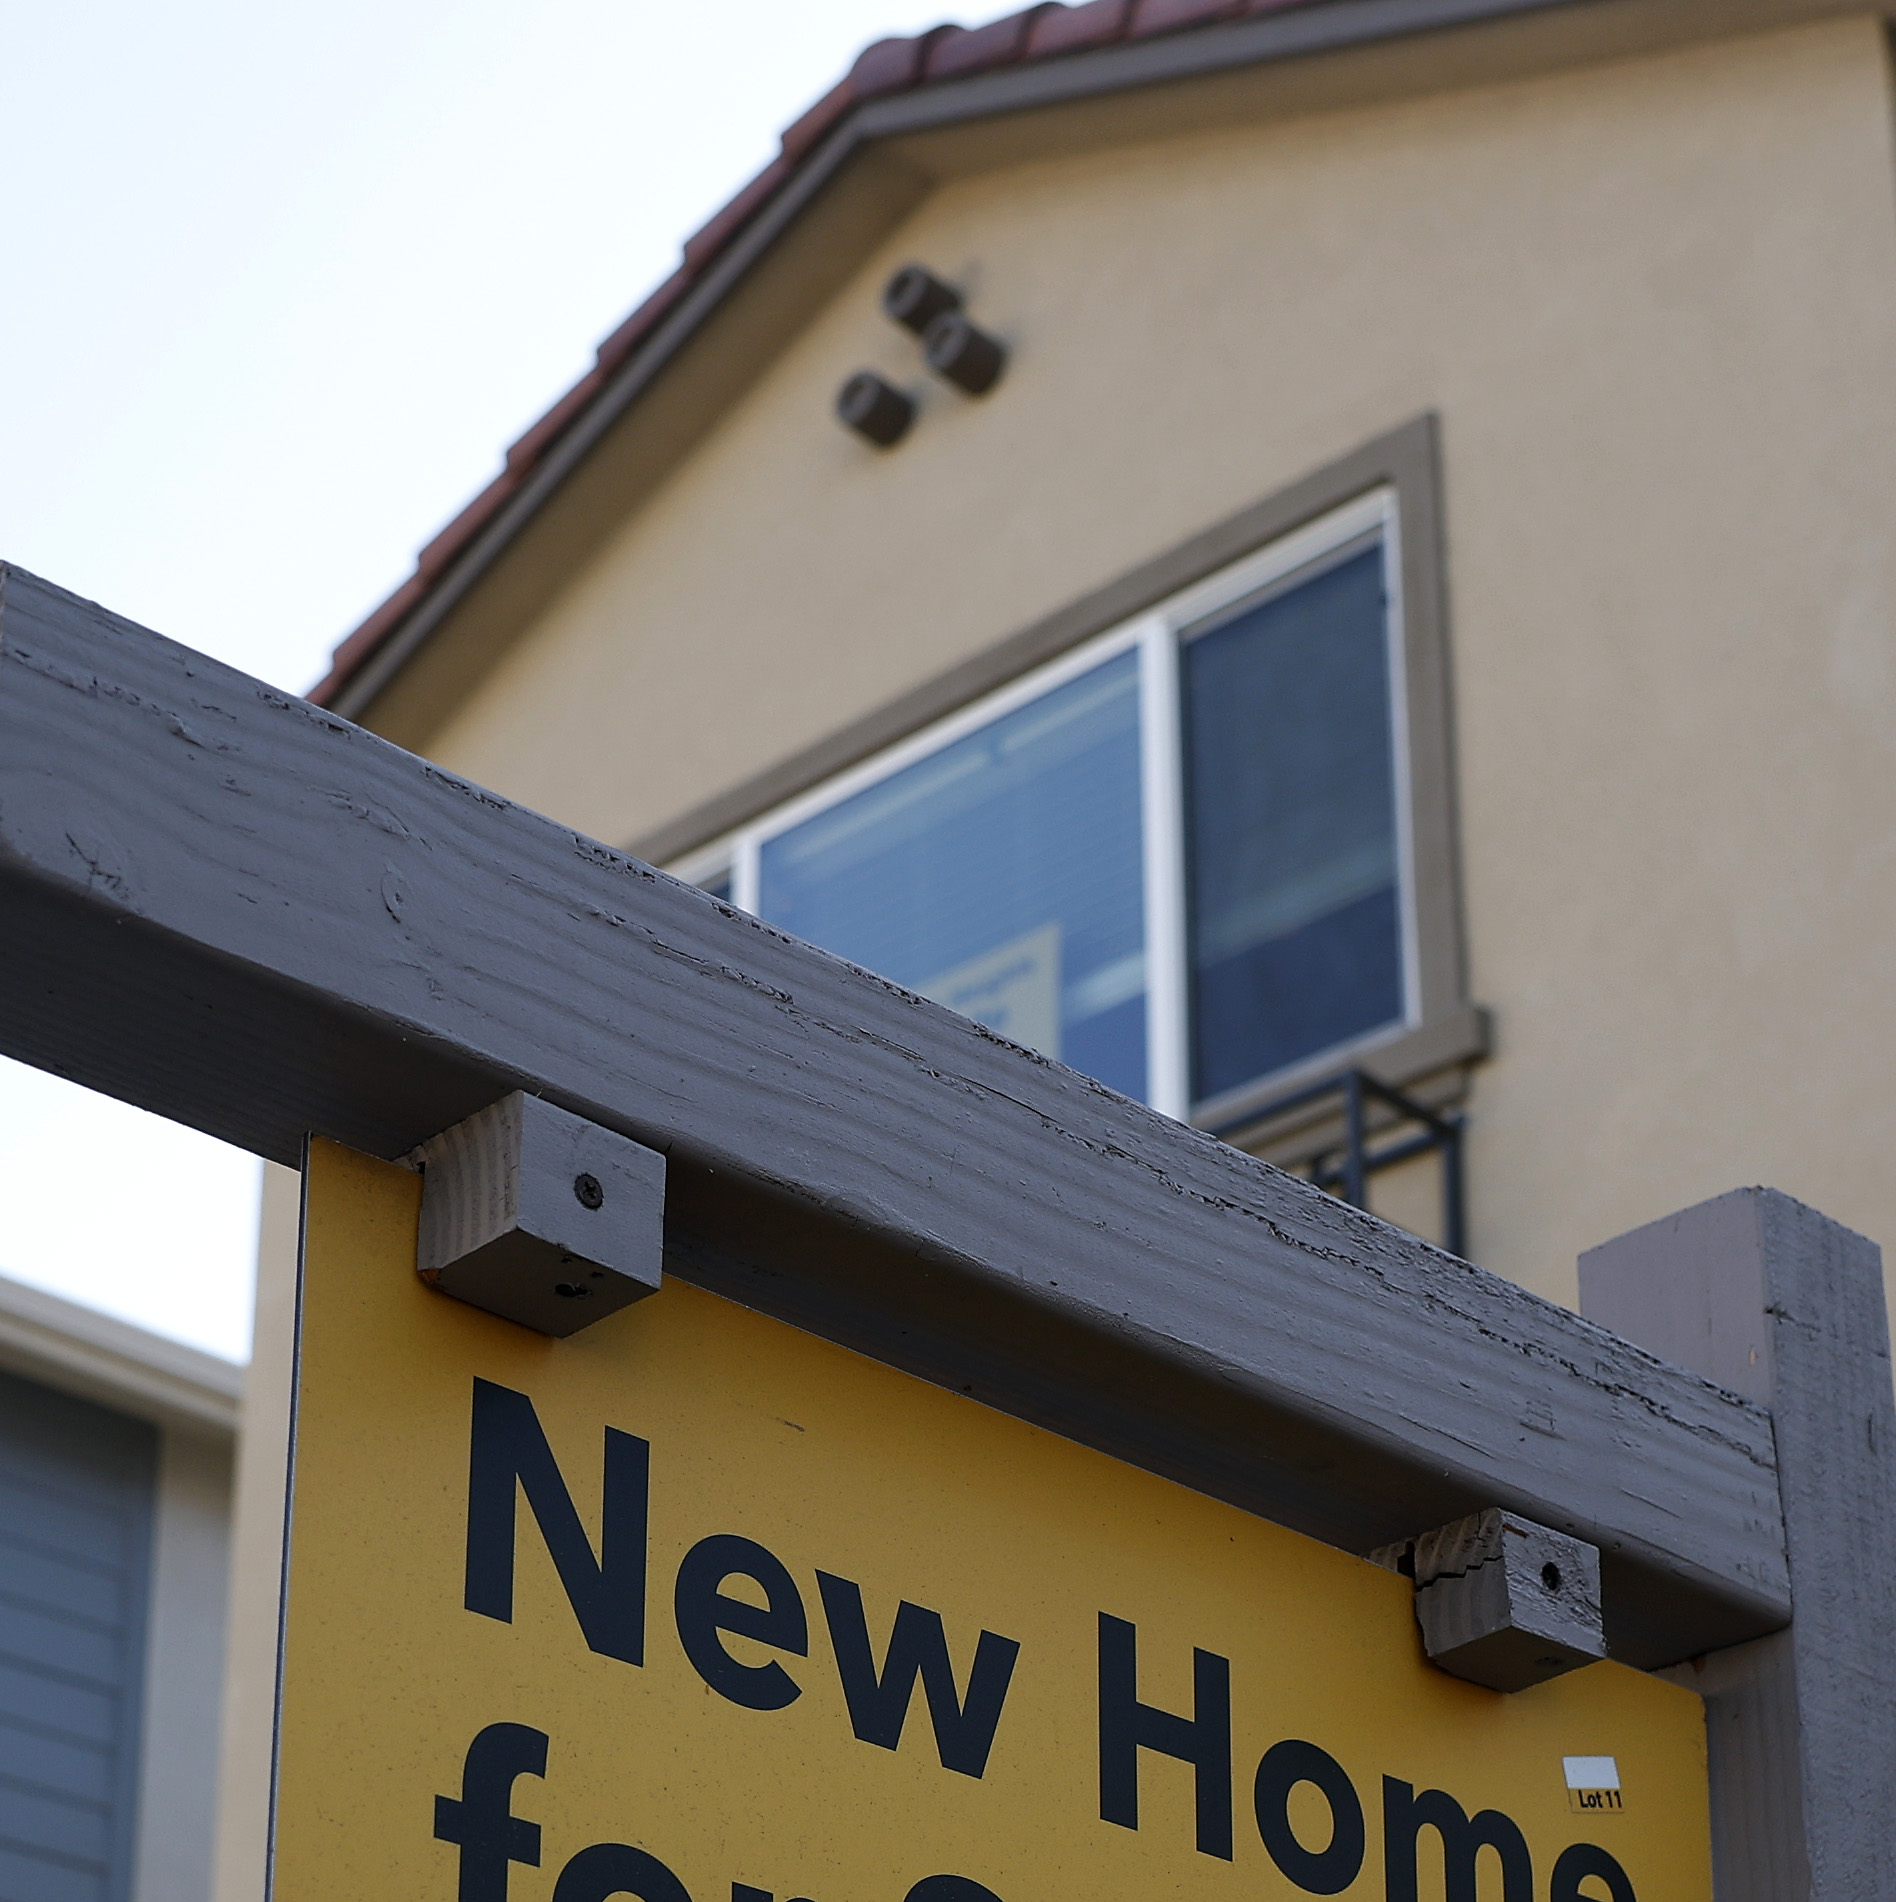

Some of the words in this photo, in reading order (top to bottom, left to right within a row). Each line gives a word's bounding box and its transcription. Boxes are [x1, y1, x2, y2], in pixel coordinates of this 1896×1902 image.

[464, 1376, 1020, 1779] New
[1579, 1790, 1603, 1808] Lot
[1606, 1791, 1623, 1808] 11
